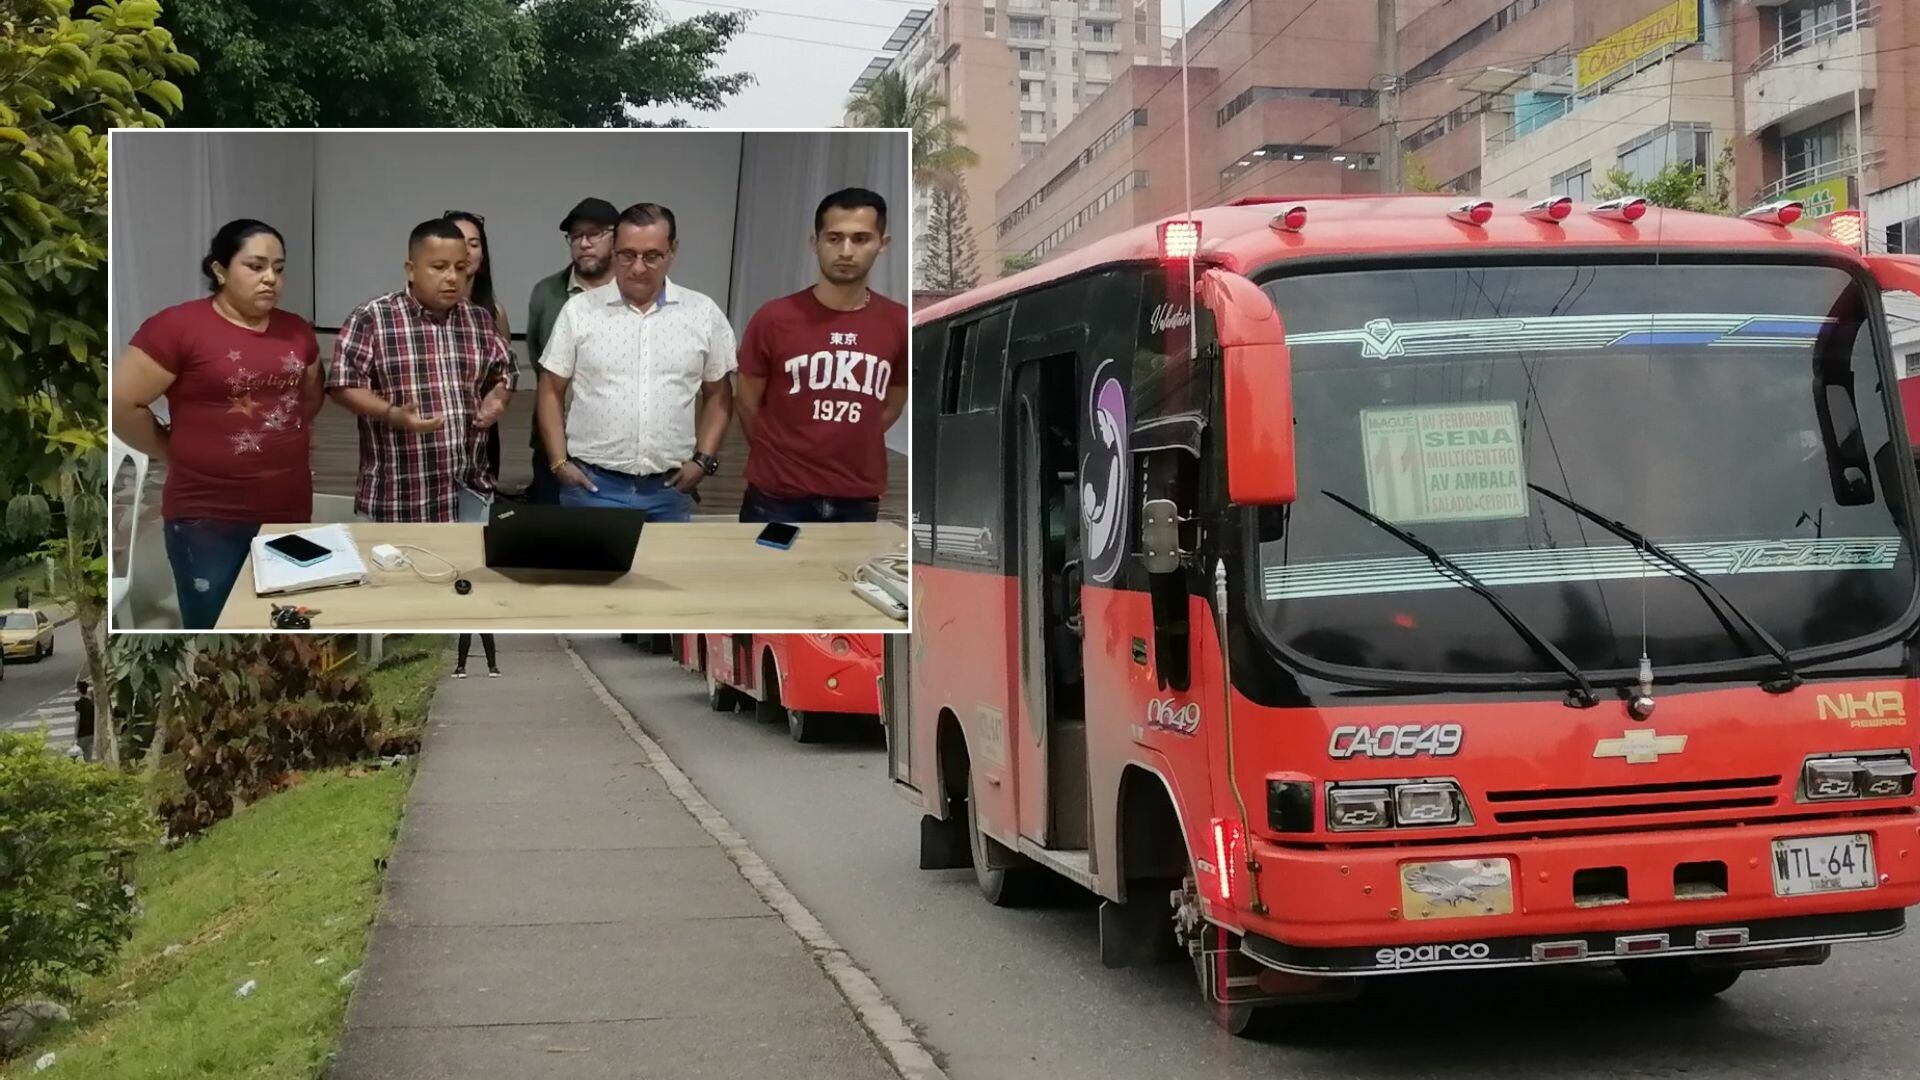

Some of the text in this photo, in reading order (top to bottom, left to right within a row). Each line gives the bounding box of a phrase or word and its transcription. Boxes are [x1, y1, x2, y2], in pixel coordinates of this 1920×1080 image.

[1589, 43, 1627, 75] CASA
[1632, 9, 1684, 52] CHINA
[830, 332, 858, 345] 東京
[785, 350, 892, 401] TOKIO
[812, 399, 862, 423] 1976
[1422, 411, 1511, 430] AV FERROCARRIL
[1425, 428, 1513, 447] SENA
[1427, 448, 1516, 468] MULTICENTRO
[1375, 435, 1424, 518] 11
[1431, 470, 1518, 491] AV AMBALA
[1148, 697, 1200, 733] 0649
[1816, 691, 1905, 720] NKR
[1850, 717, 1906, 728] REWARD
[1828, 843, 1867, 875] 647
[1376, 943, 1489, 969] sparco
